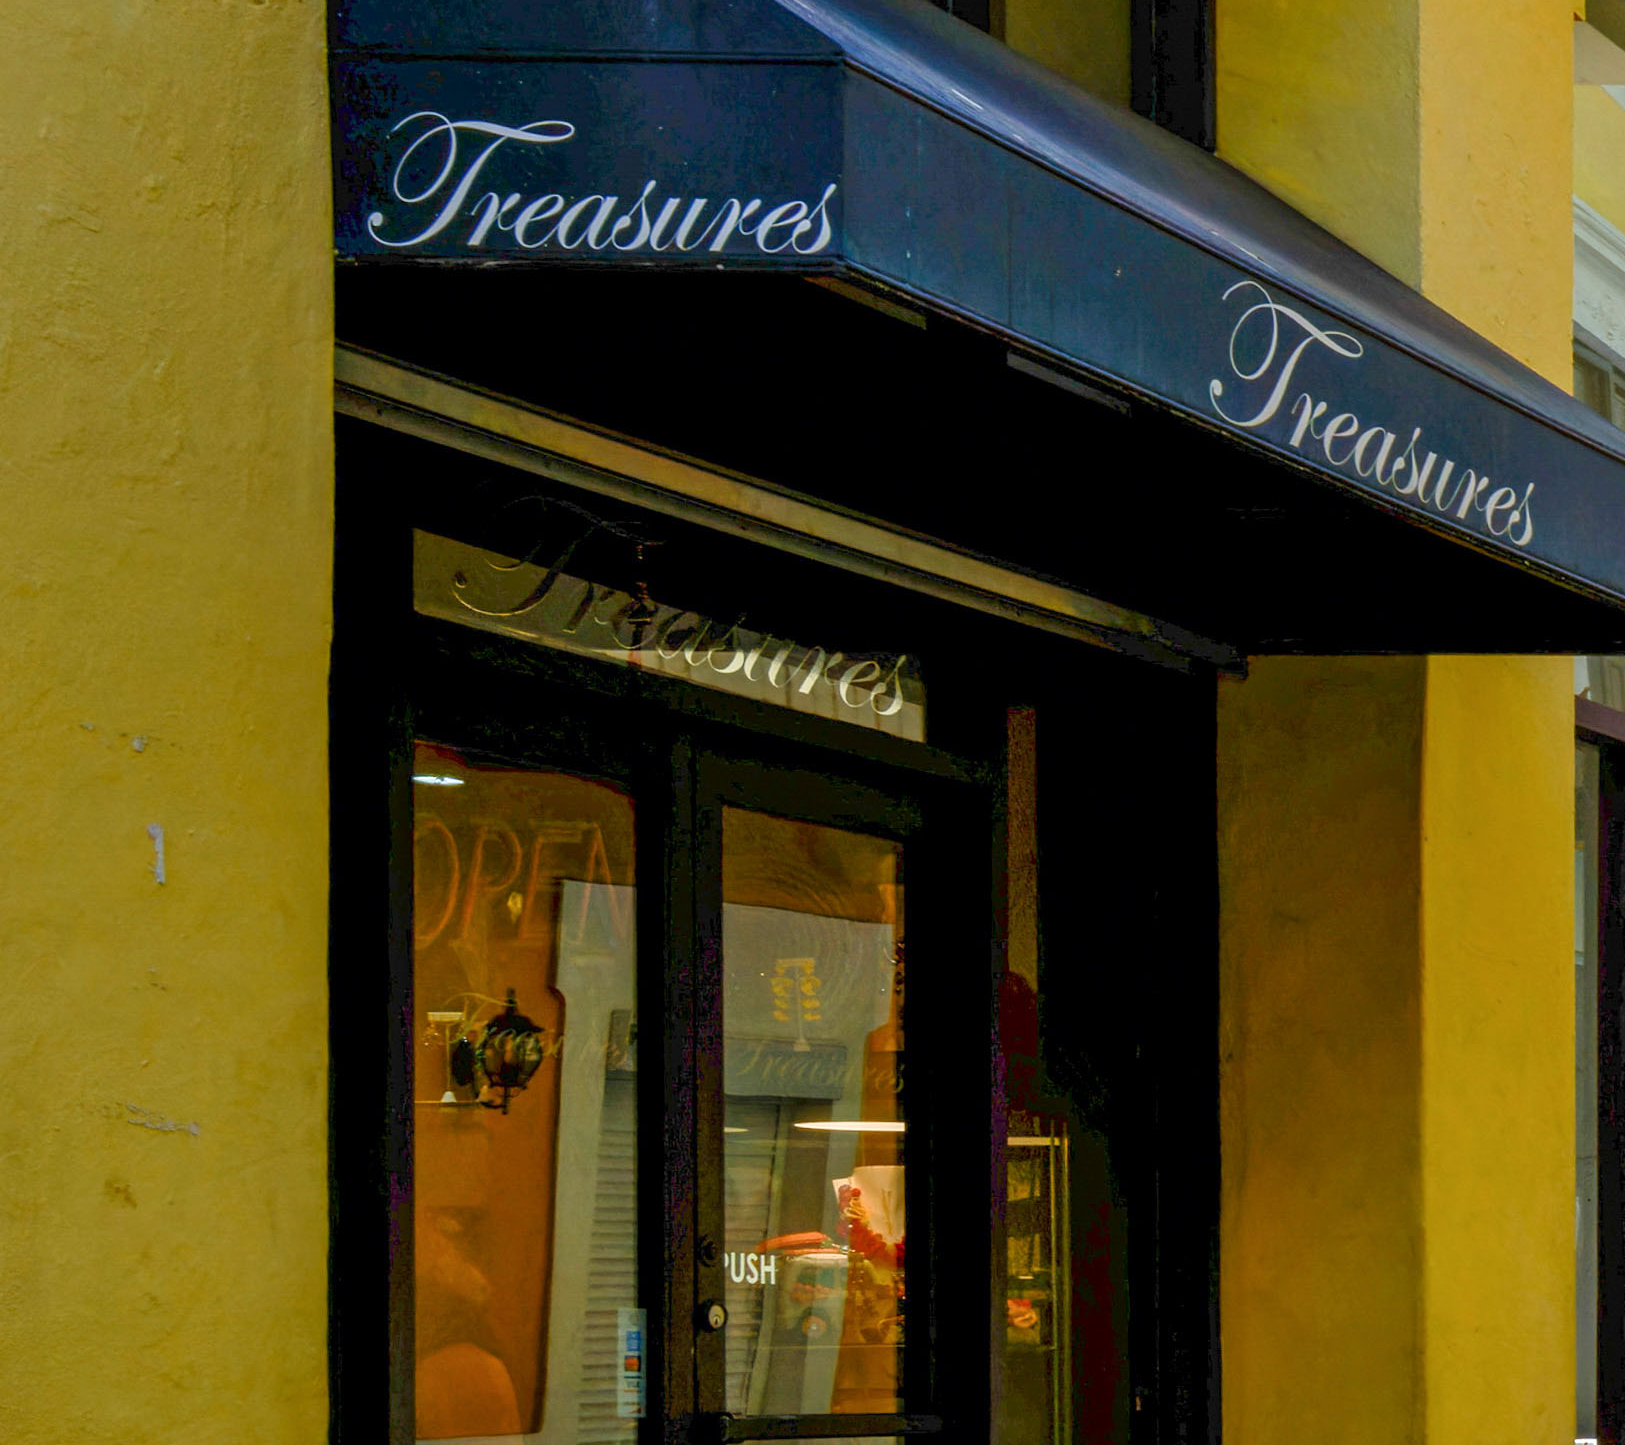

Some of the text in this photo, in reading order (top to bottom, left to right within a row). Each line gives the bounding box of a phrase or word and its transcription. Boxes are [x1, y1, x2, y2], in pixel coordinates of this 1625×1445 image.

[367, 110, 837, 253] Treasures
[1210, 280, 1536, 546] Treasures
[452, 494, 907, 718] Treasures
[724, 1252, 776, 1285] USH
